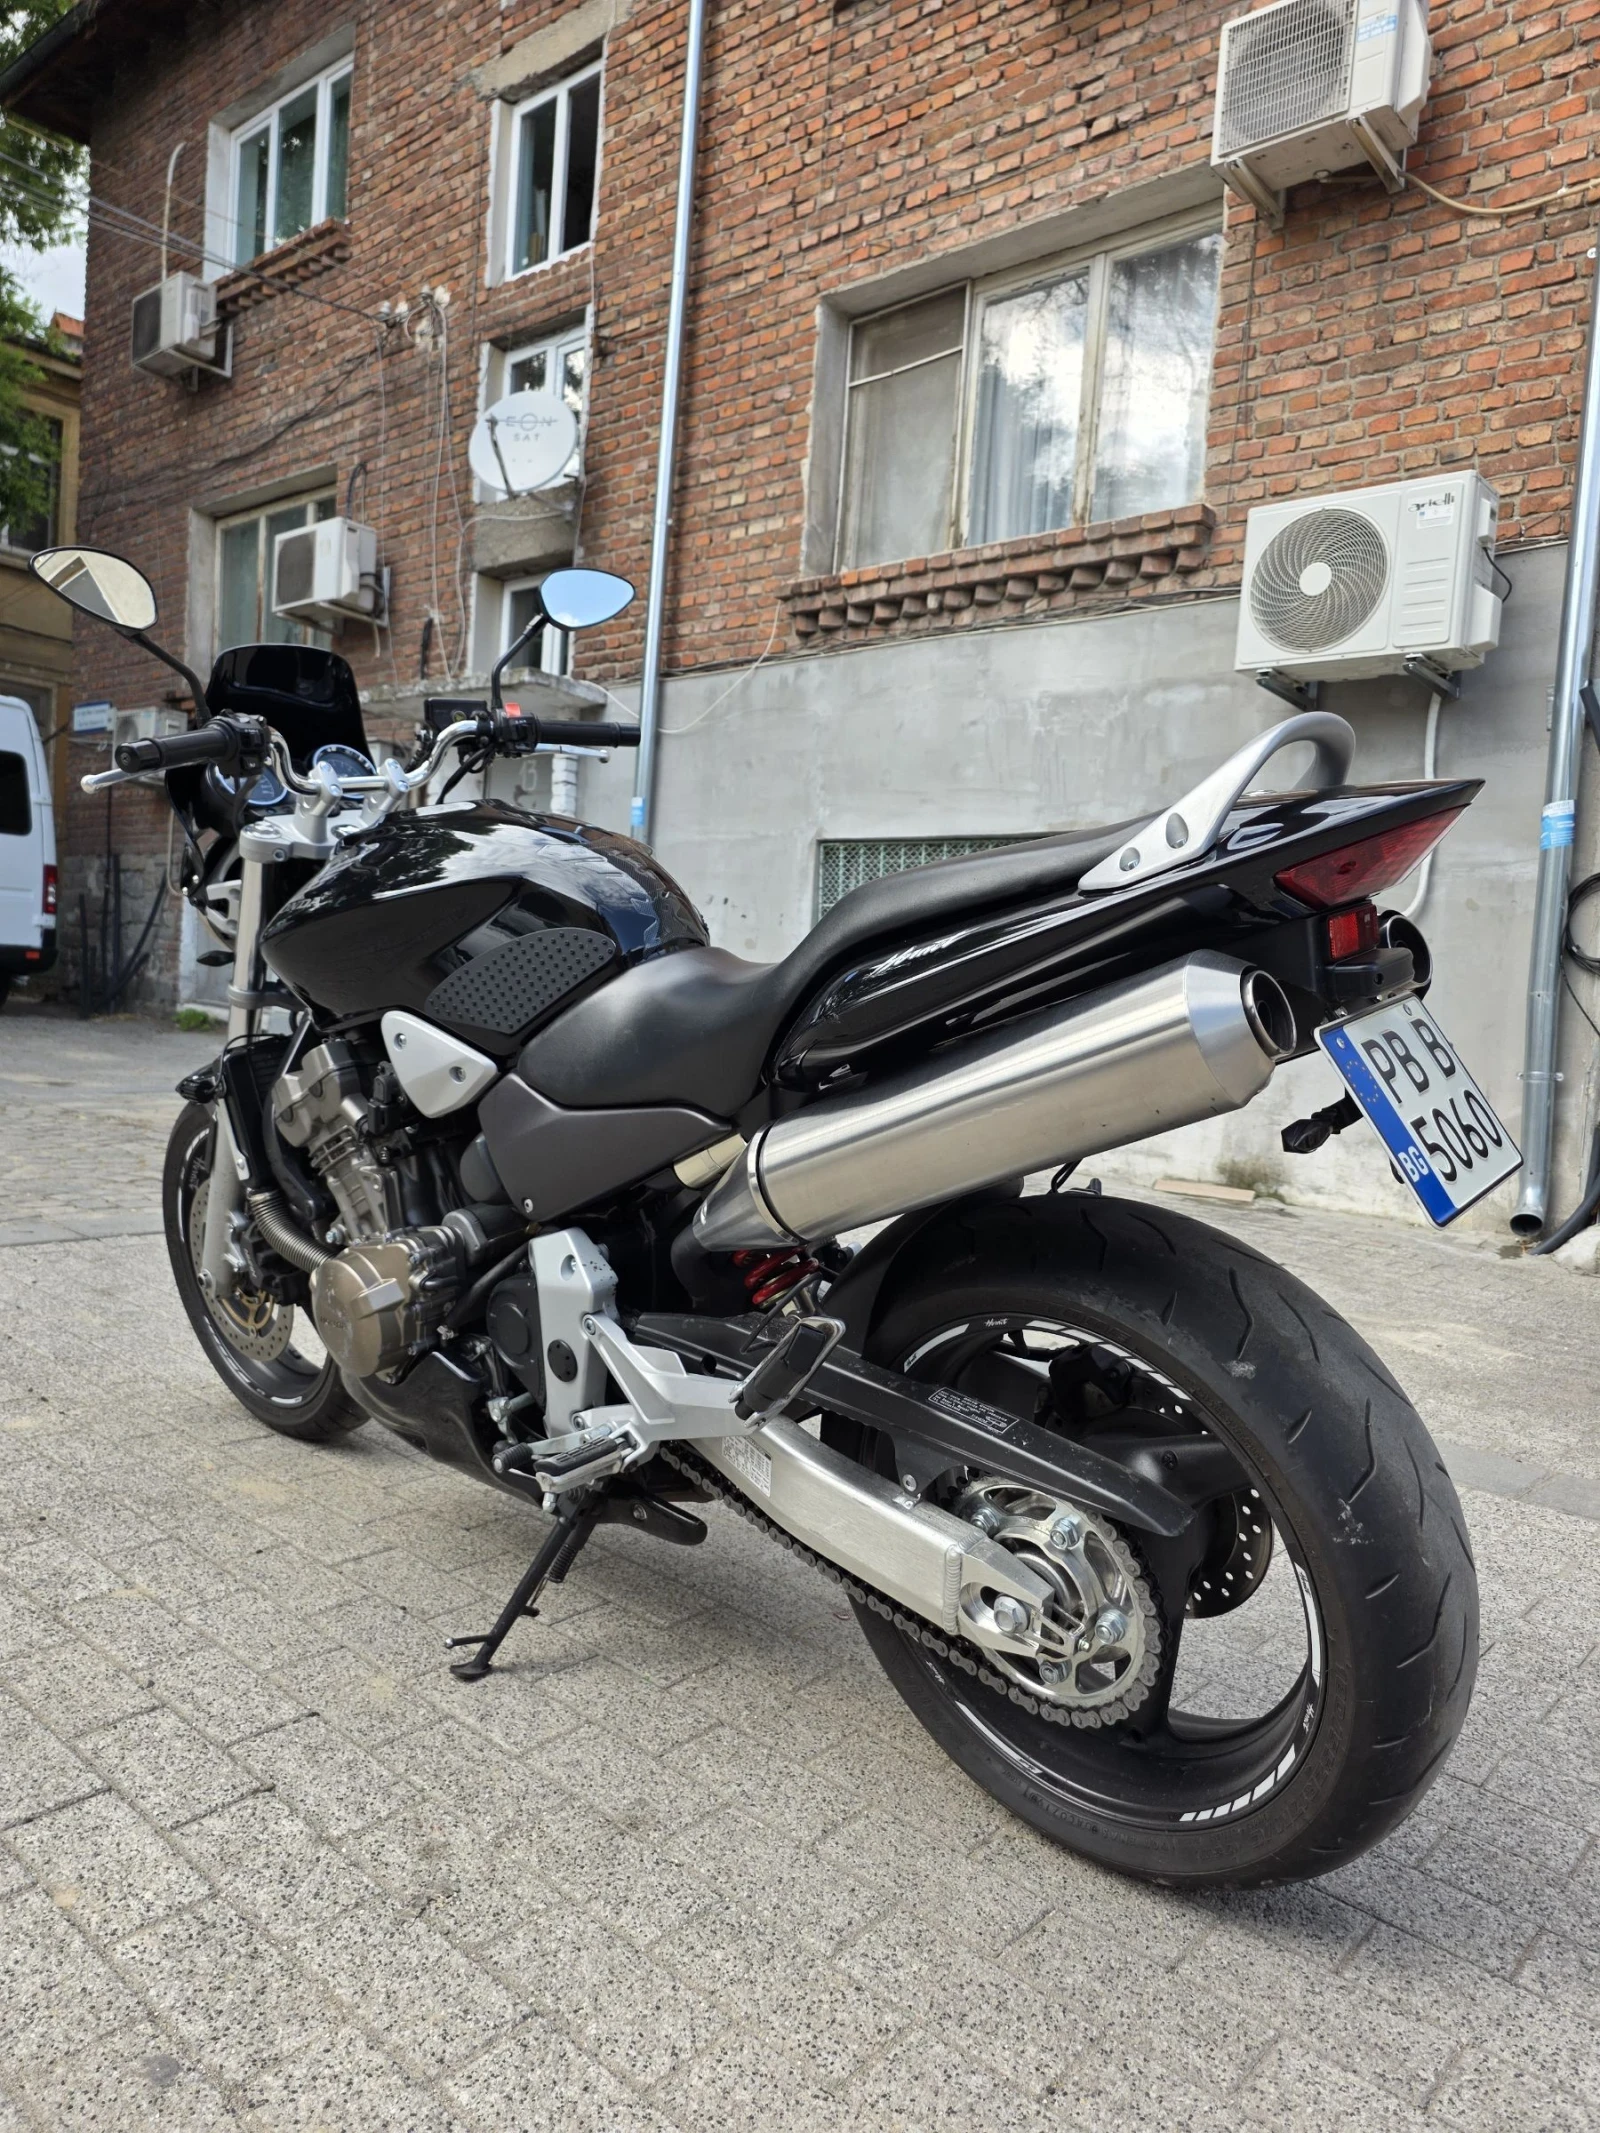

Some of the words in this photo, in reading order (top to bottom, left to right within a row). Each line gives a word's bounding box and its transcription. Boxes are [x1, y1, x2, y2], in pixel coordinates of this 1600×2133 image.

[513, 433, 540, 442] SAT
[1410, 1090, 1503, 1182] 5060
[1398, 1146, 1430, 1183] BG
